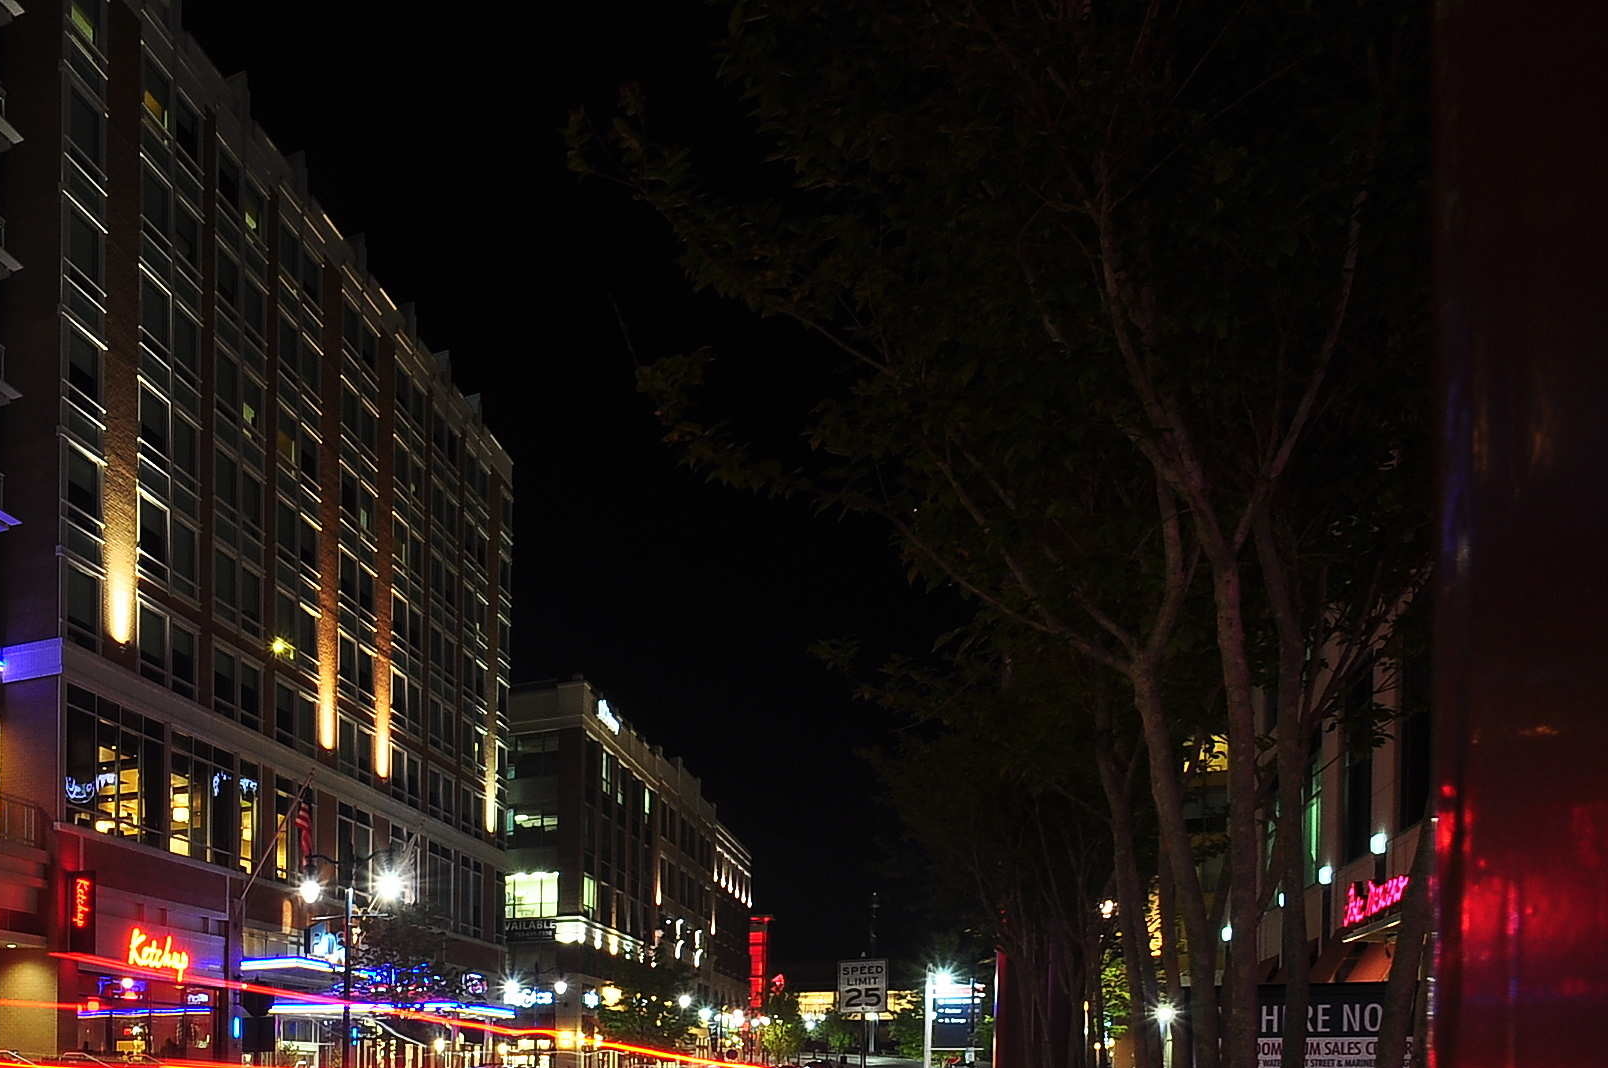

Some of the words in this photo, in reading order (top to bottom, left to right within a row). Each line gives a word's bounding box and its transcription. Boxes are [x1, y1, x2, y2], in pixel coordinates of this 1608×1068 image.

[72, 878, 90, 928] Ketchup
[504, 919, 556, 931] VAILABLE
[128, 927, 189, 982] Ketchup
[842, 965, 884, 976] SPEED
[846, 976, 880, 986] LIMIT
[844, 987, 882, 1007] 25
[1260, 1004, 1331, 1033] HRE
[1342, 1003, 1384, 1032] NO
[1324, 1041, 1362, 1056] SALES
[1309, 1059, 1335, 1067] STREET
[1344, 1059, 1375, 1067] MARINE
